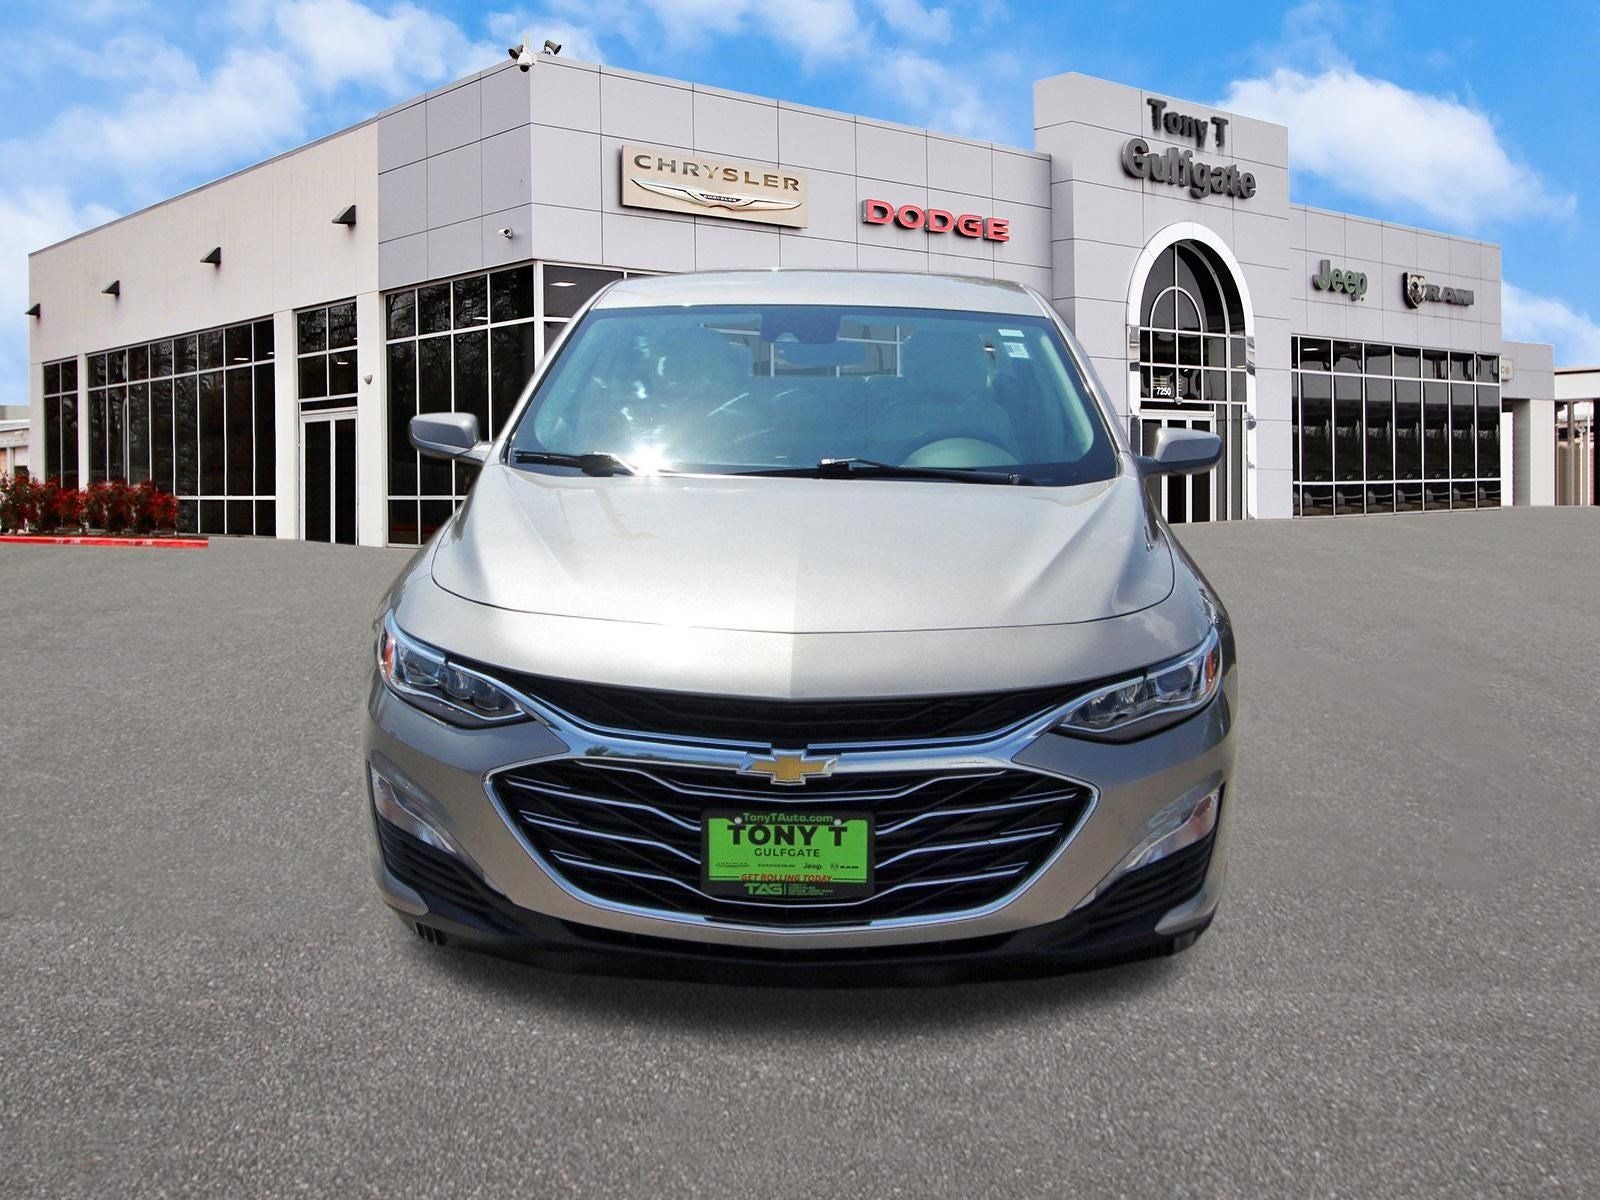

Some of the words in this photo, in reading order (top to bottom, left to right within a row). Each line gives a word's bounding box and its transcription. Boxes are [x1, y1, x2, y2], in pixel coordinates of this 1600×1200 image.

[1147, 98, 1208, 147] Tony
[1210, 117, 1229, 147] T
[633, 154, 800, 192] CHRYSLER
[1121, 138, 1256, 199] Gulfgate
[863, 198, 1010, 242] DODGE
[1312, 259, 1368, 301] Jeep
[1425, 284, 1475, 306] RAM
[1156, 387, 1172, 396] 7250
[742, 812, 833, 824] TonyTAuto.com
[727, 825, 819, 846] TONY
[828, 826, 848, 847] T
[754, 848, 821, 858] GULFGATE
[741, 873, 761, 882] GET
[761, 874, 801, 882] ROLLING
[803, 874, 833, 883] TODAY
